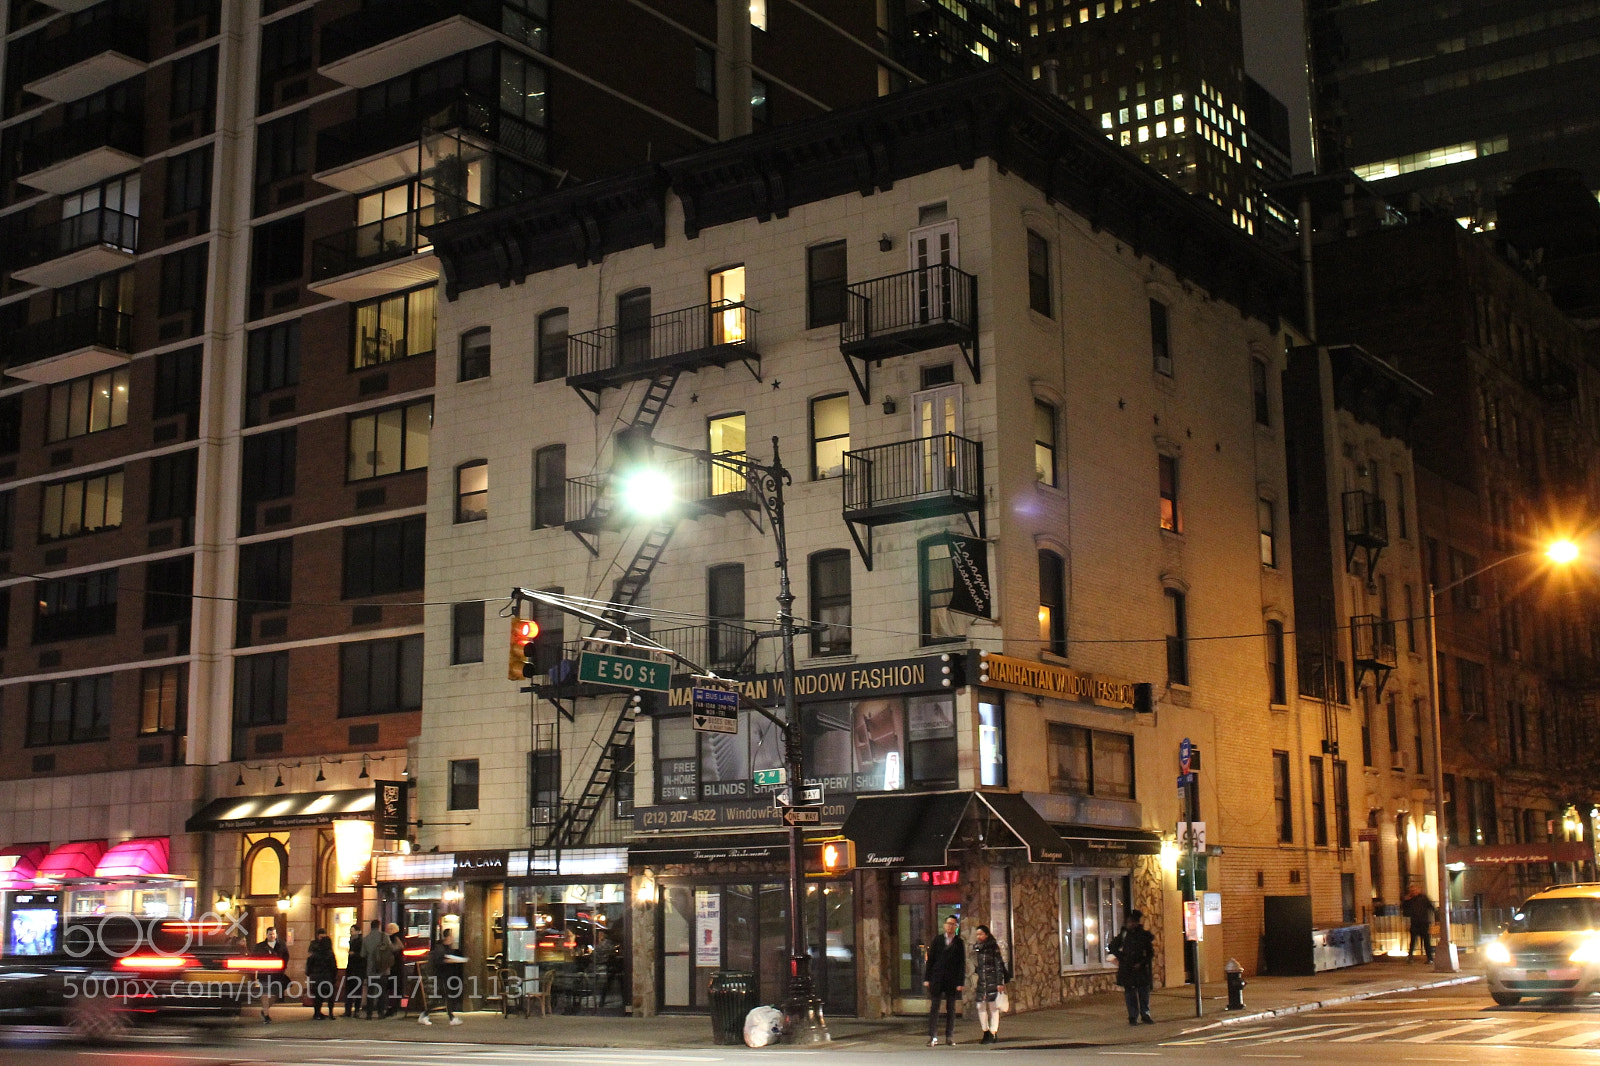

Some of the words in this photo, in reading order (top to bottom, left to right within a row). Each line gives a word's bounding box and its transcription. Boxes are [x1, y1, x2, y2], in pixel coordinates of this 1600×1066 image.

[597, 660, 608, 678] E
[613, 662, 634, 681] 50
[638, 666, 656, 684] St
[668, 680, 768, 706] MATAN
[772, 672, 846, 697] WNDOW
[852, 664, 925, 690] FASHION
[989, 660, 1053, 691] MANHATTAN
[1055, 673, 1096, 699] WINDOW
[1098, 681, 1135, 705] FASHION
[705, 692, 718, 700] BUS
[719, 694, 736, 702] LANE
[673, 761, 696, 773] FREE
[663, 774, 696, 785] IN-HOME
[758, 772, 766, 784] 2
[662, 786, 697, 798] ESTIMATE
[704, 783, 746, 797] BLINDS
[801, 791, 818, 799] WAY
[643, 811, 668, 827] (212)
[670, 808, 717, 824] 207-4522
[789, 813, 801, 821] ONE
[805, 812, 817, 821] WAY
[459, 858, 472, 868] LA
[476, 857, 502, 868] CAVA
[866, 852, 905, 866] Lasagna
